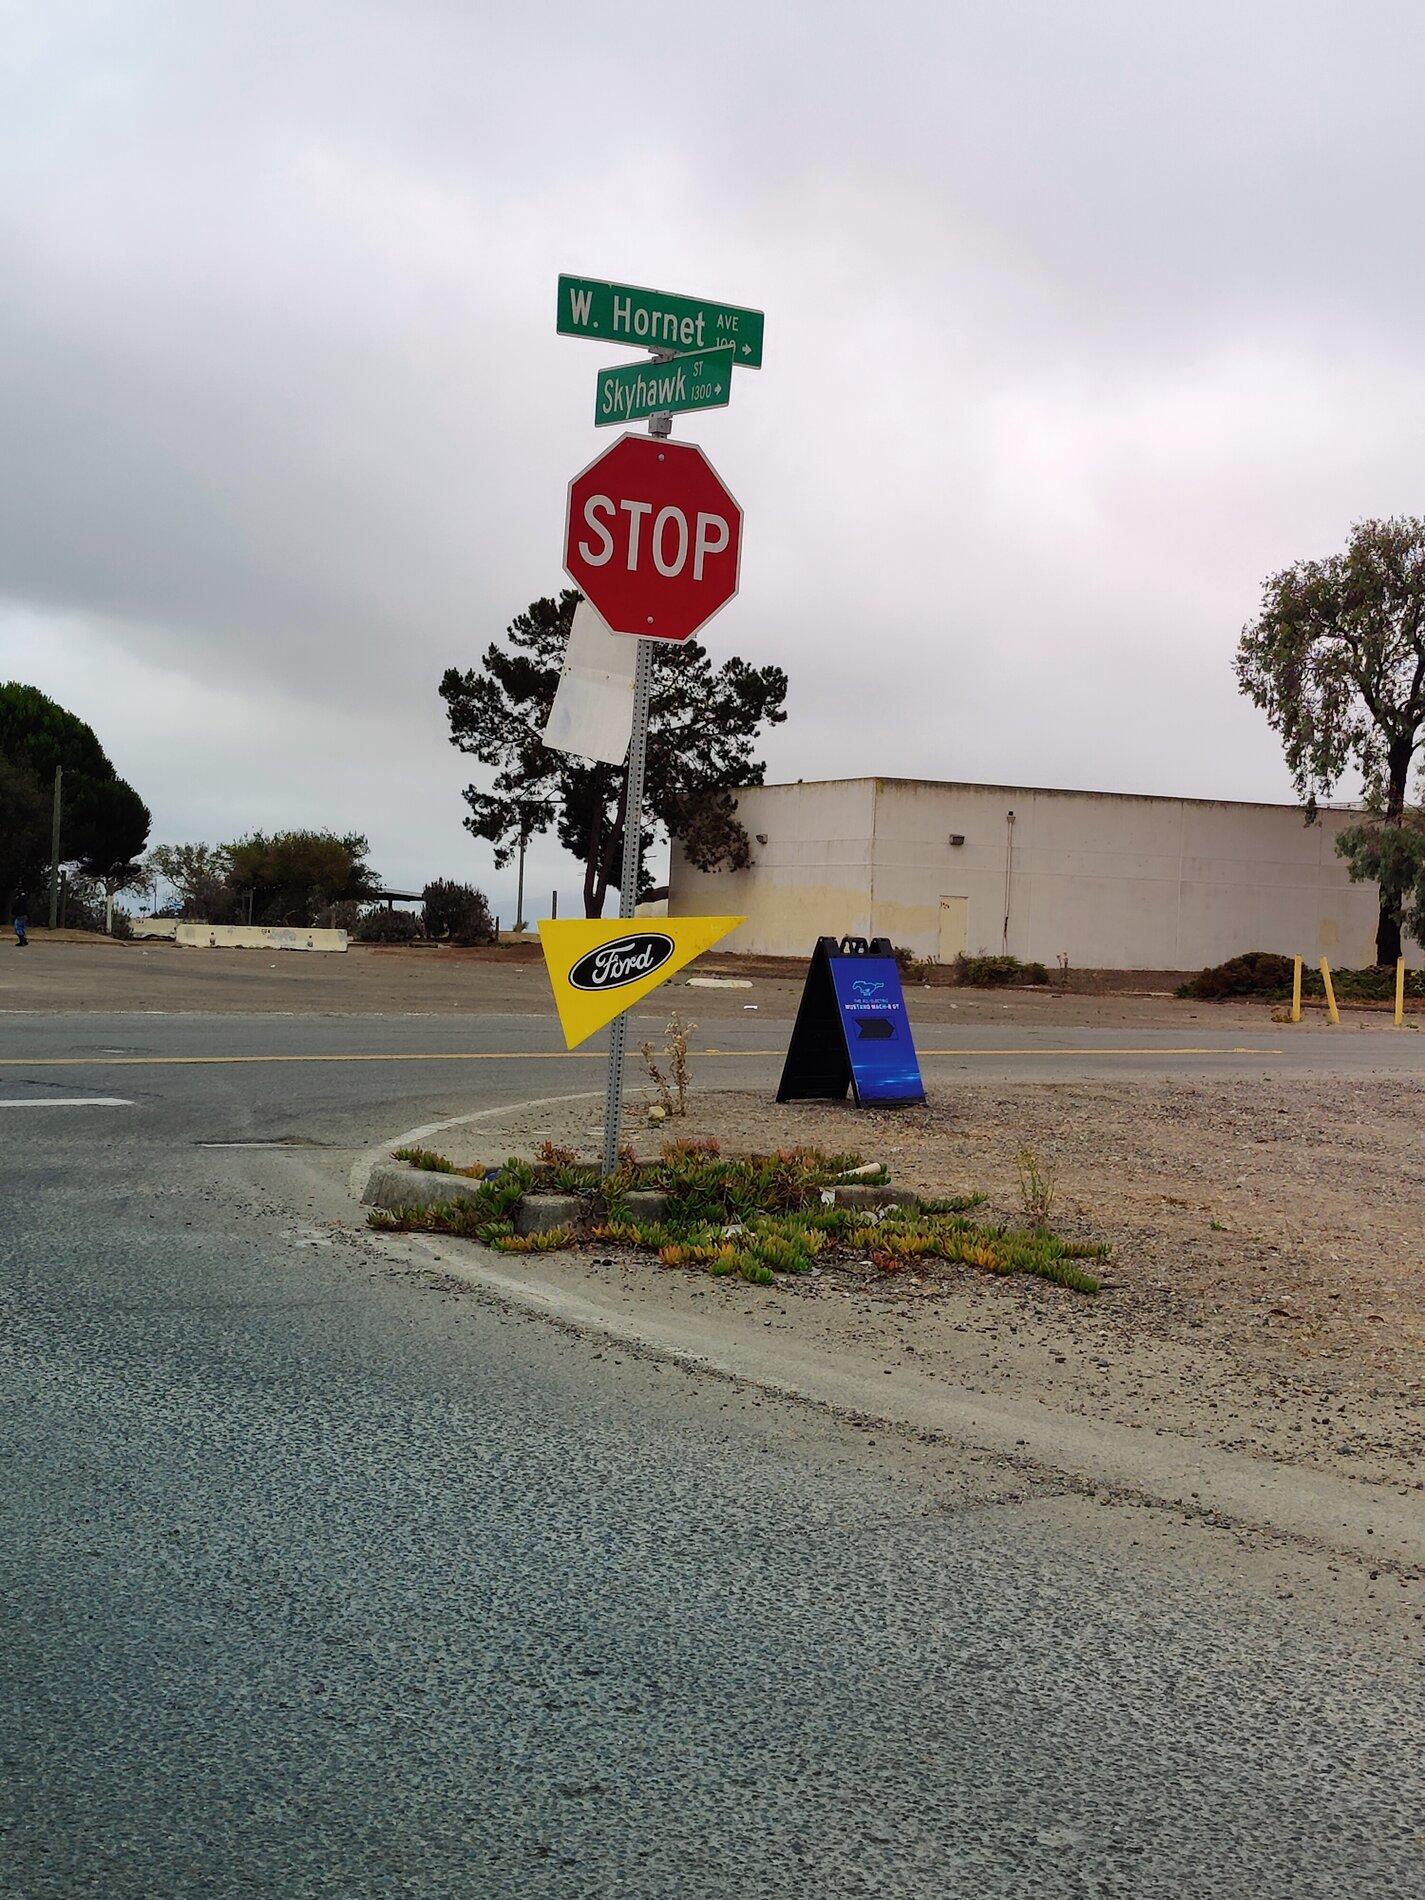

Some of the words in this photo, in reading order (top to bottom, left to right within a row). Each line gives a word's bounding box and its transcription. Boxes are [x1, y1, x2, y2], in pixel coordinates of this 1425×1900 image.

[570, 288, 599, 328] W.
[613, 295, 705, 347] Hornet
[716, 314, 739, 332] AVE
[602, 367, 686, 419] Skyhawk
[692, 361, 704, 377] ST
[690, 383, 712, 401] 1300
[578, 494, 730, 581] STOP
[592, 943, 654, 984] Ford
